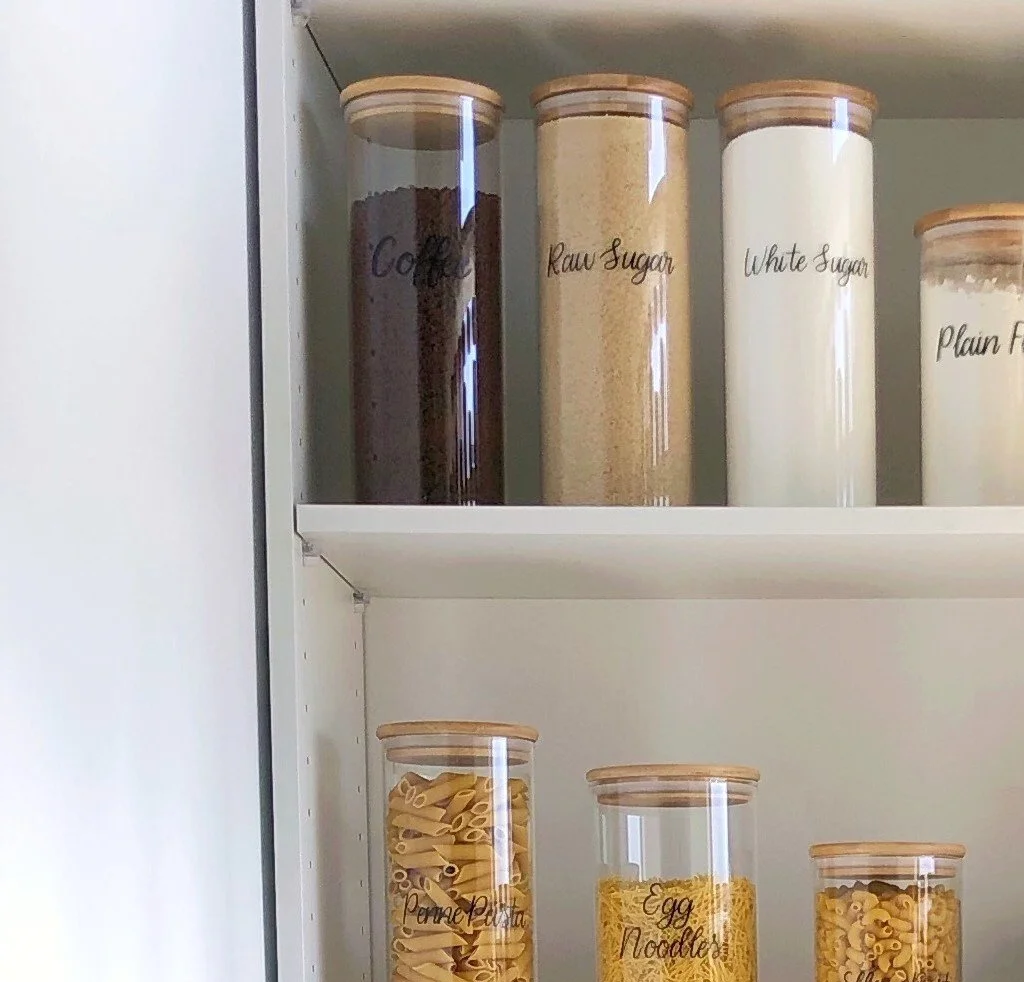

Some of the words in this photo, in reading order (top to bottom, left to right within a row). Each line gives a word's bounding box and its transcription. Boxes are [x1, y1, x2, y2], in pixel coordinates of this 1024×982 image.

[547, 241, 596, 277] Raw
[599, 237, 674, 285] Sugar
[744, 242, 808, 278] White
[812, 243, 869, 287] Sugar
[935, 323, 1001, 363] Plain
[402, 892, 466, 925] Penne
[466, 895, 526, 929] Pasta
[642, 882, 696, 931] Egg
[620, 925, 722, 960] Noodles
